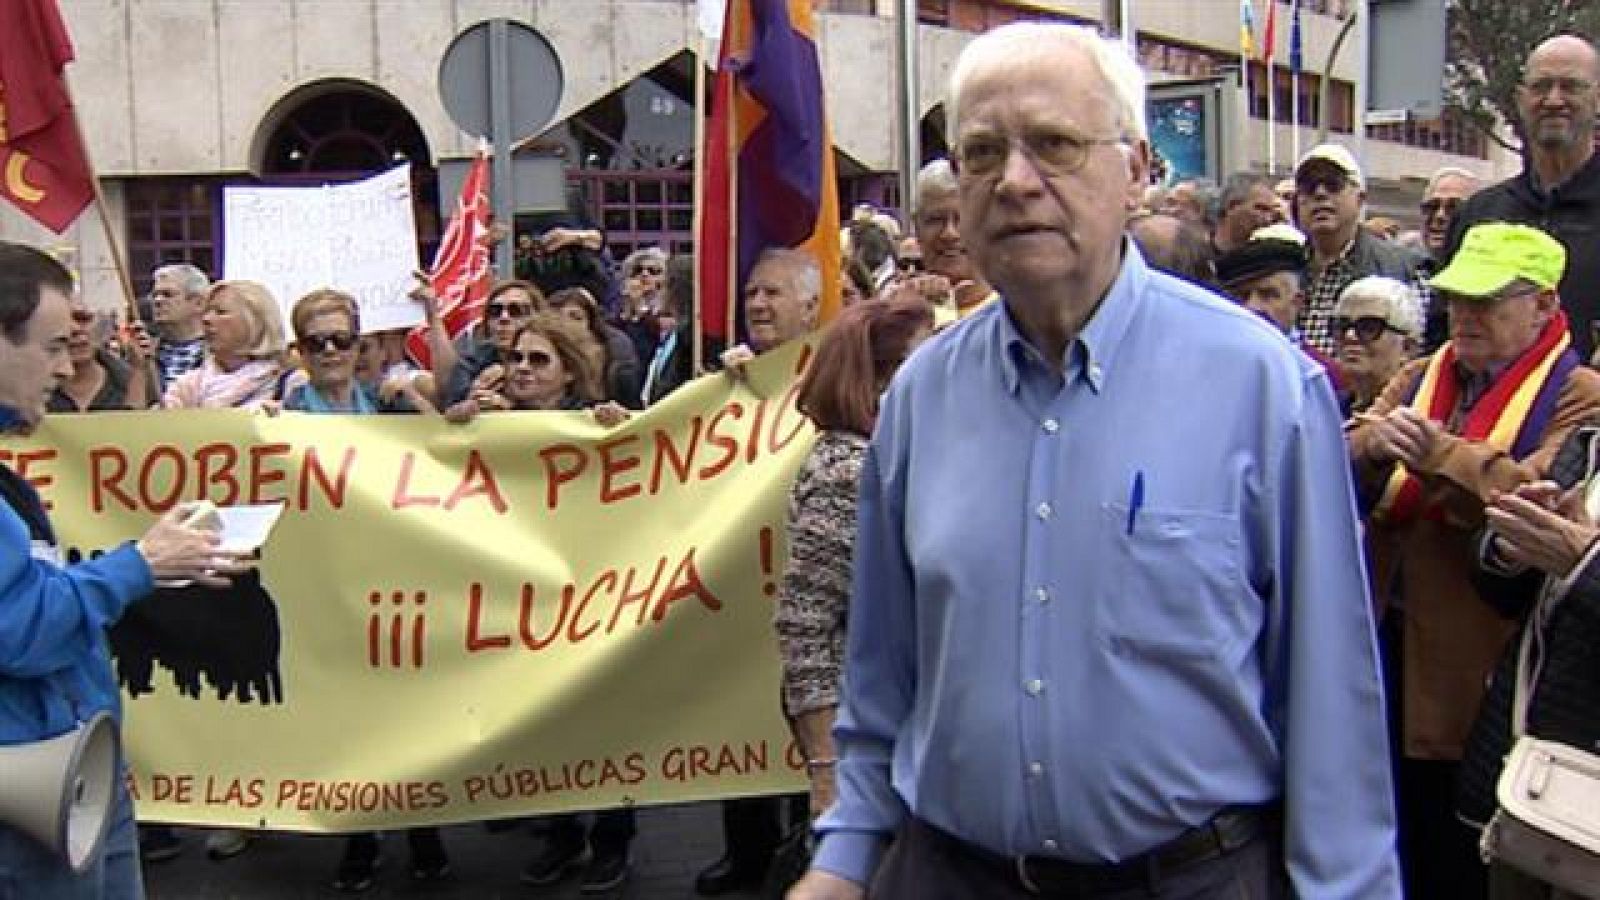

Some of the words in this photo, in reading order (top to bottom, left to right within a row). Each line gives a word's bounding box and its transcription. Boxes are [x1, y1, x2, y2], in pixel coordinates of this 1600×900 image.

[89, 444, 357, 513] ROBEN
[391, 449, 507, 513] LA
[466, 548, 721, 653] LUCHA
[152, 775, 194, 802] DE
[205, 777, 264, 808] LAS
[276, 780, 448, 812] PENSIONES
[463, 752, 648, 801] PÚBLICAS
[661, 739, 768, 782] GRAN
